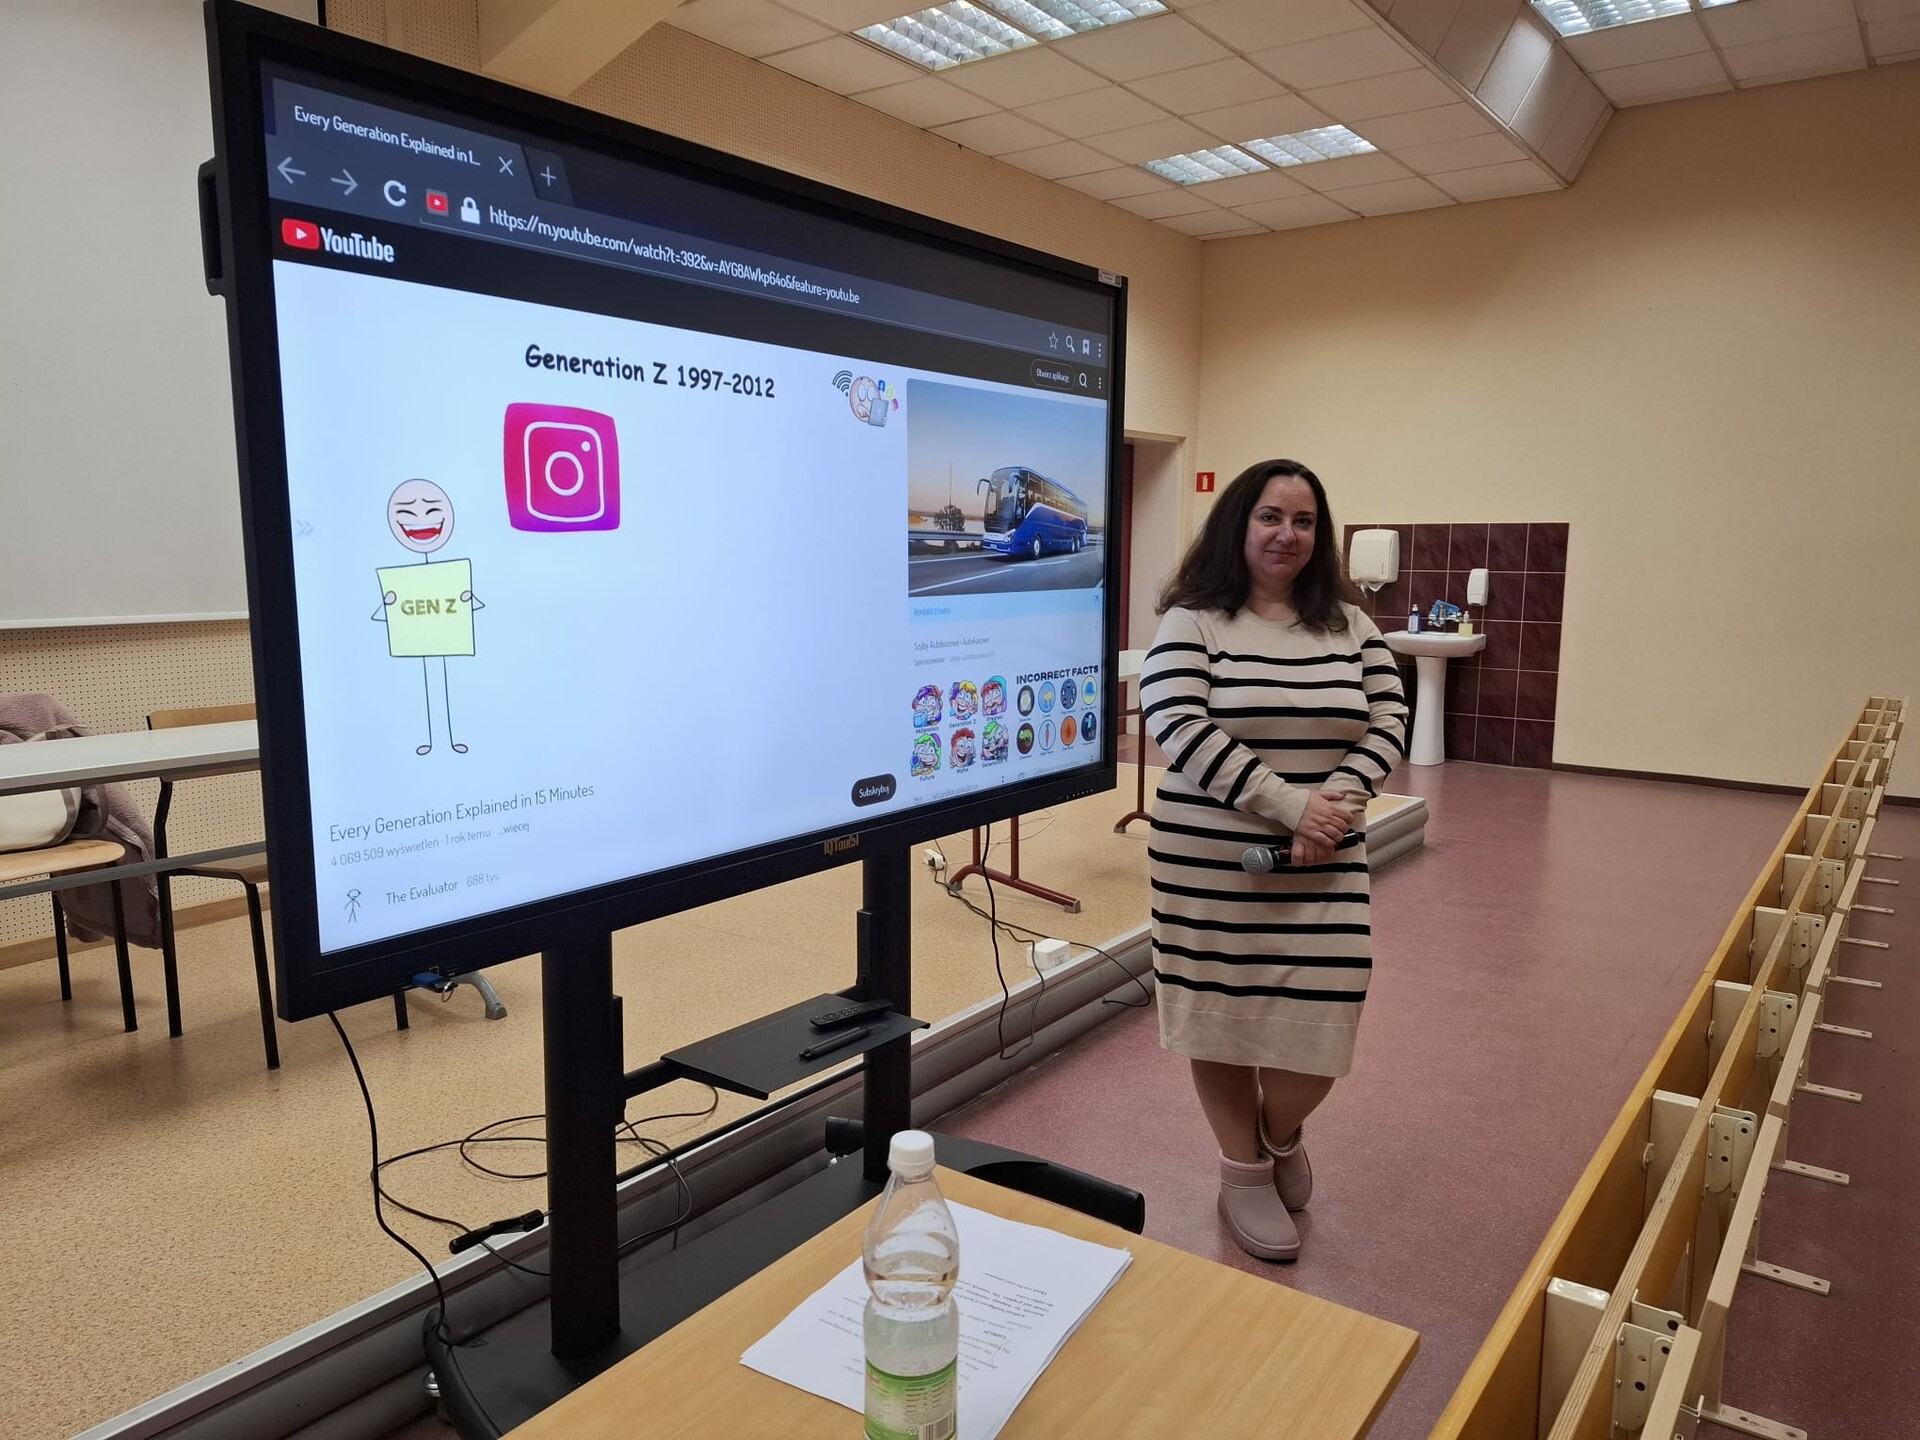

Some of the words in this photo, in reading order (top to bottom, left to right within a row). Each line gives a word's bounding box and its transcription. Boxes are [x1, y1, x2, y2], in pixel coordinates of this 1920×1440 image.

[294, 105, 330, 131] Every
[332, 115, 399, 145] Generation
[400, 132, 454, 160] Explained
[456, 149, 467, 163] in
[320, 226, 395, 264] YouTube
[525, 343, 645, 383] Generation
[652, 361, 669, 386] Z
[677, 365, 776, 399] 1997-2012
[401, 599, 440, 616] GEN
[445, 598, 457, 614] Z
[1016, 668, 1071, 685] INCORRECT
[1071, 664, 1099, 677] FACTS
[329, 822, 371, 842] Every
[374, 811, 453, 834] Generation
[455, 794, 519, 821] Explained
[521, 793, 533, 808] in
[535, 791, 547, 806] 15
[549, 783, 596, 804] Minutes
[331, 857, 338, 867] 4
[339, 850, 362, 866] 069
[363, 846, 385, 862] 509
[386, 835, 440, 858] wyświetleń
[451, 832, 466, 844] rok
[467, 828, 491, 843] temu
[386, 891, 407, 905] The
[410, 880, 459, 900] Evaluator
[466, 873, 485, 888] 688
